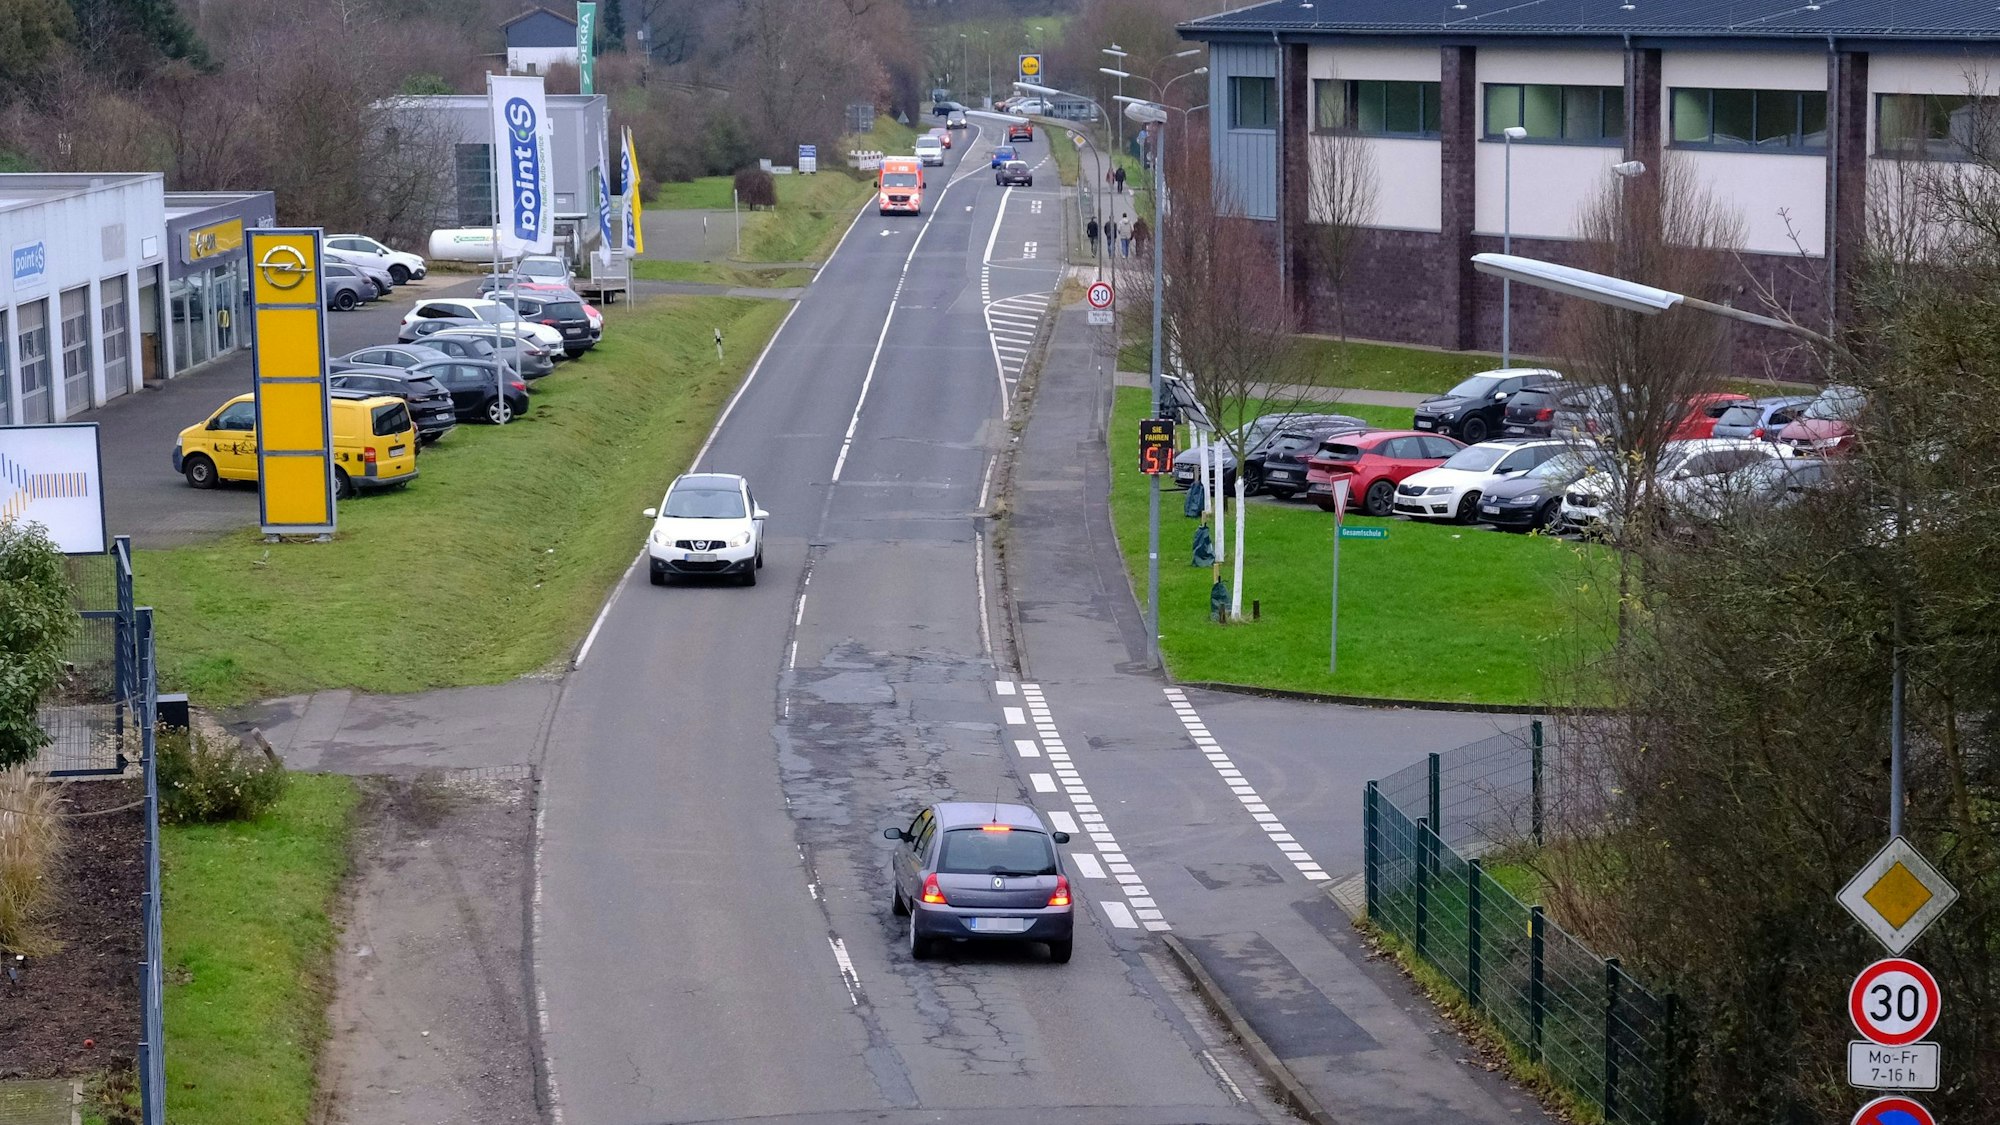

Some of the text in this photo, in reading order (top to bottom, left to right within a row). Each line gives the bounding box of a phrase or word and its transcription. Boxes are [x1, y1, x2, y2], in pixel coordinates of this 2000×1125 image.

[580, 12, 591, 65] DEKRA
[514, 146, 536, 231] point
[15, 250, 35, 275] point
[1093, 289, 1108, 301] 30
[1146, 447, 1172, 472] 51
[1342, 529, 1381, 537] Gesamtschule
[1870, 984, 1919, 1022] 30
[1869, 1050, 1918, 1064] Mo-Fr
[1872, 1068, 1915, 1081] 7-16 h
